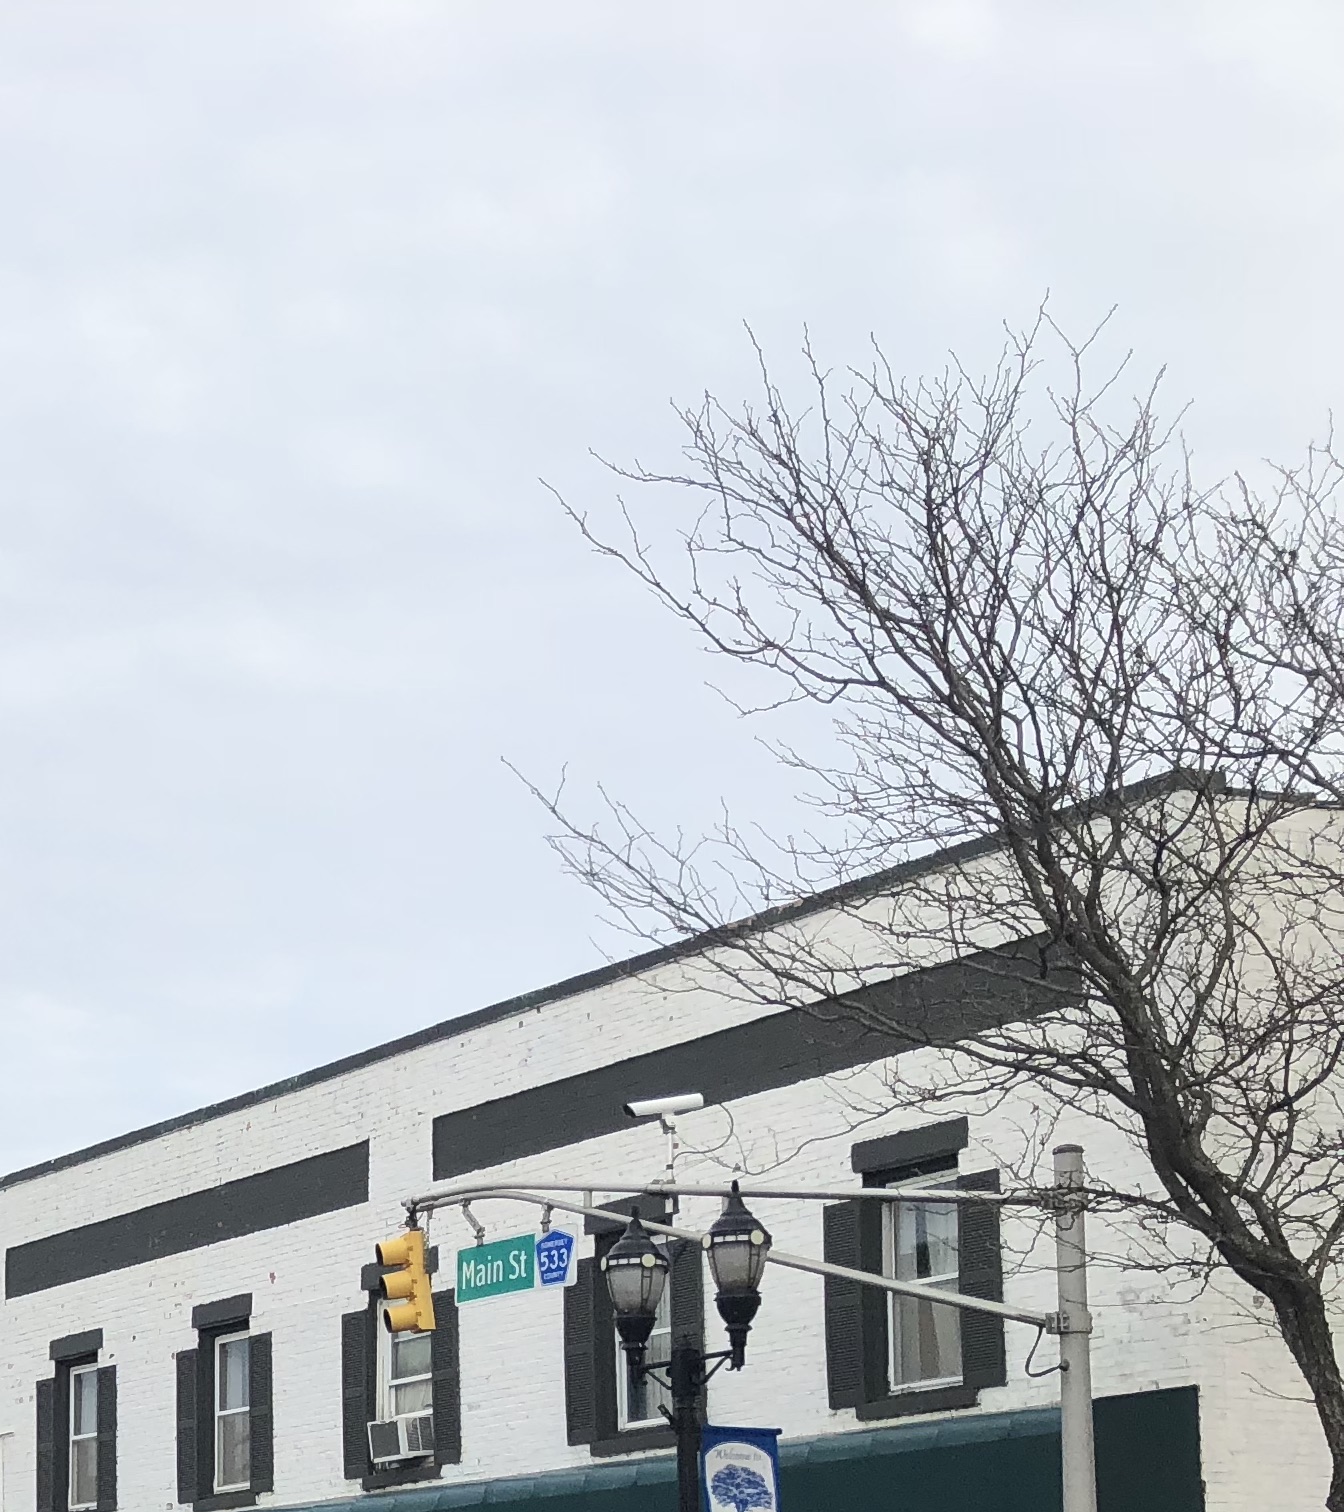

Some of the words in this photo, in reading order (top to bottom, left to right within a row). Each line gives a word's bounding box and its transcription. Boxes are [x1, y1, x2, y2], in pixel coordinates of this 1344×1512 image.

[462, 1255, 503, 1289] Main
[509, 1250, 527, 1279] St
[540, 1248, 568, 1271] 533
